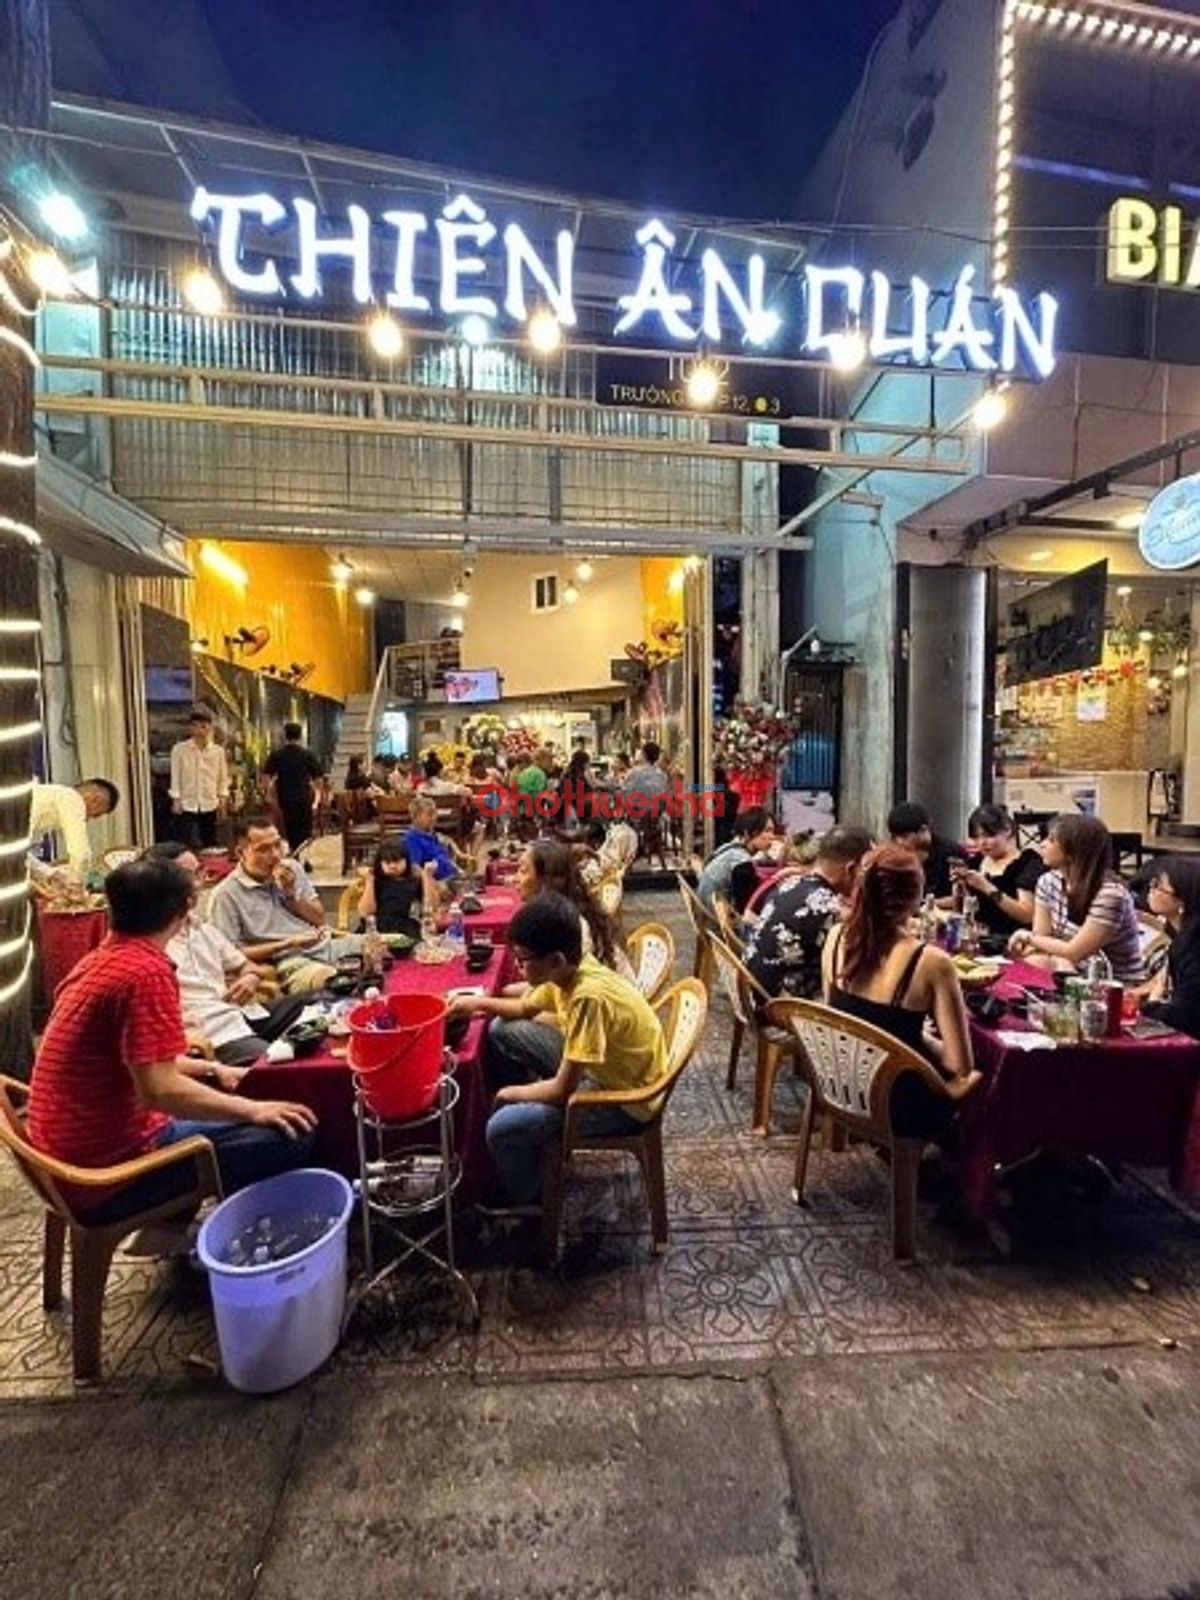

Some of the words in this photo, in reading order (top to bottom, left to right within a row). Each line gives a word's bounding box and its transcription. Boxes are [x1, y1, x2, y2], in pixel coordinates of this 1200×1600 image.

[191, 186, 577, 326] THIÊN
[613, 218, 770, 344] ÂN
[802, 263, 1059, 377] QUÁN
